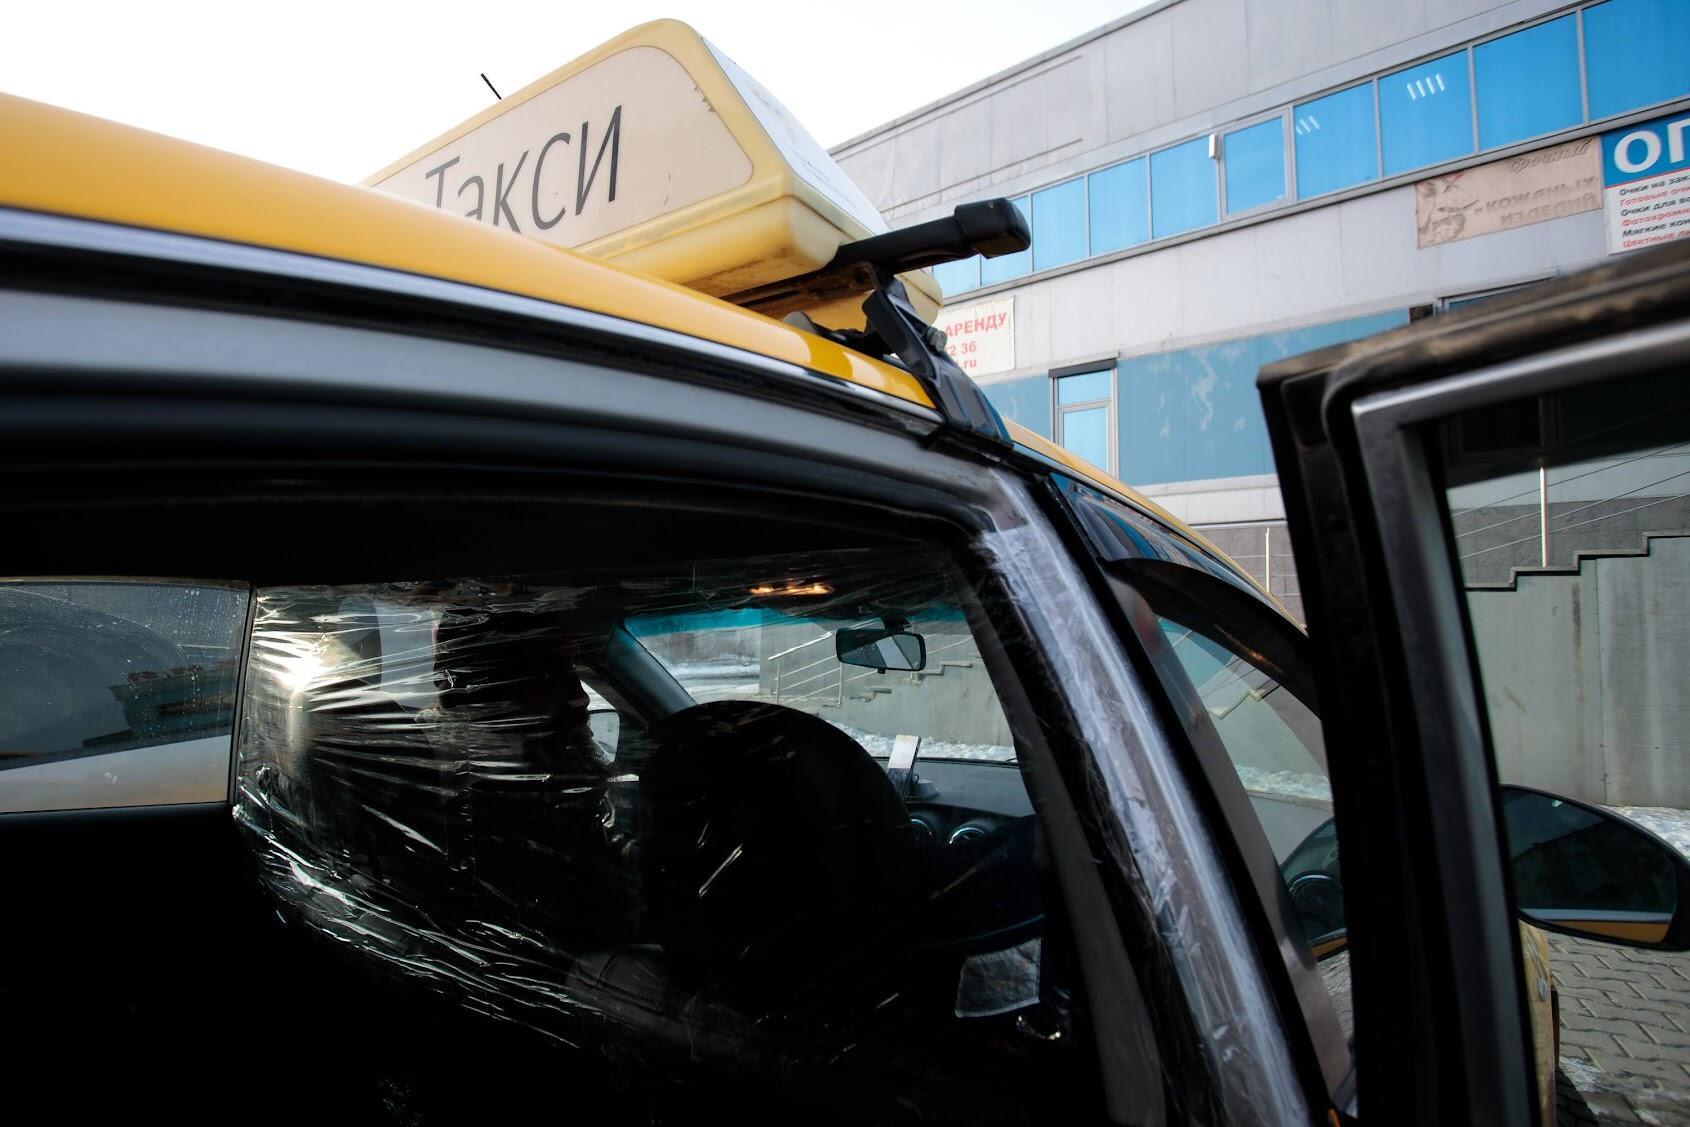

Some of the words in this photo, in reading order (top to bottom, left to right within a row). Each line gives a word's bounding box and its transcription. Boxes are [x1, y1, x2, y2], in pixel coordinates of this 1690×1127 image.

[1669, 175, 1690, 185] зак
[945, 311, 1007, 337] АРЕНДУ
[961, 340, 977, 354] 36
